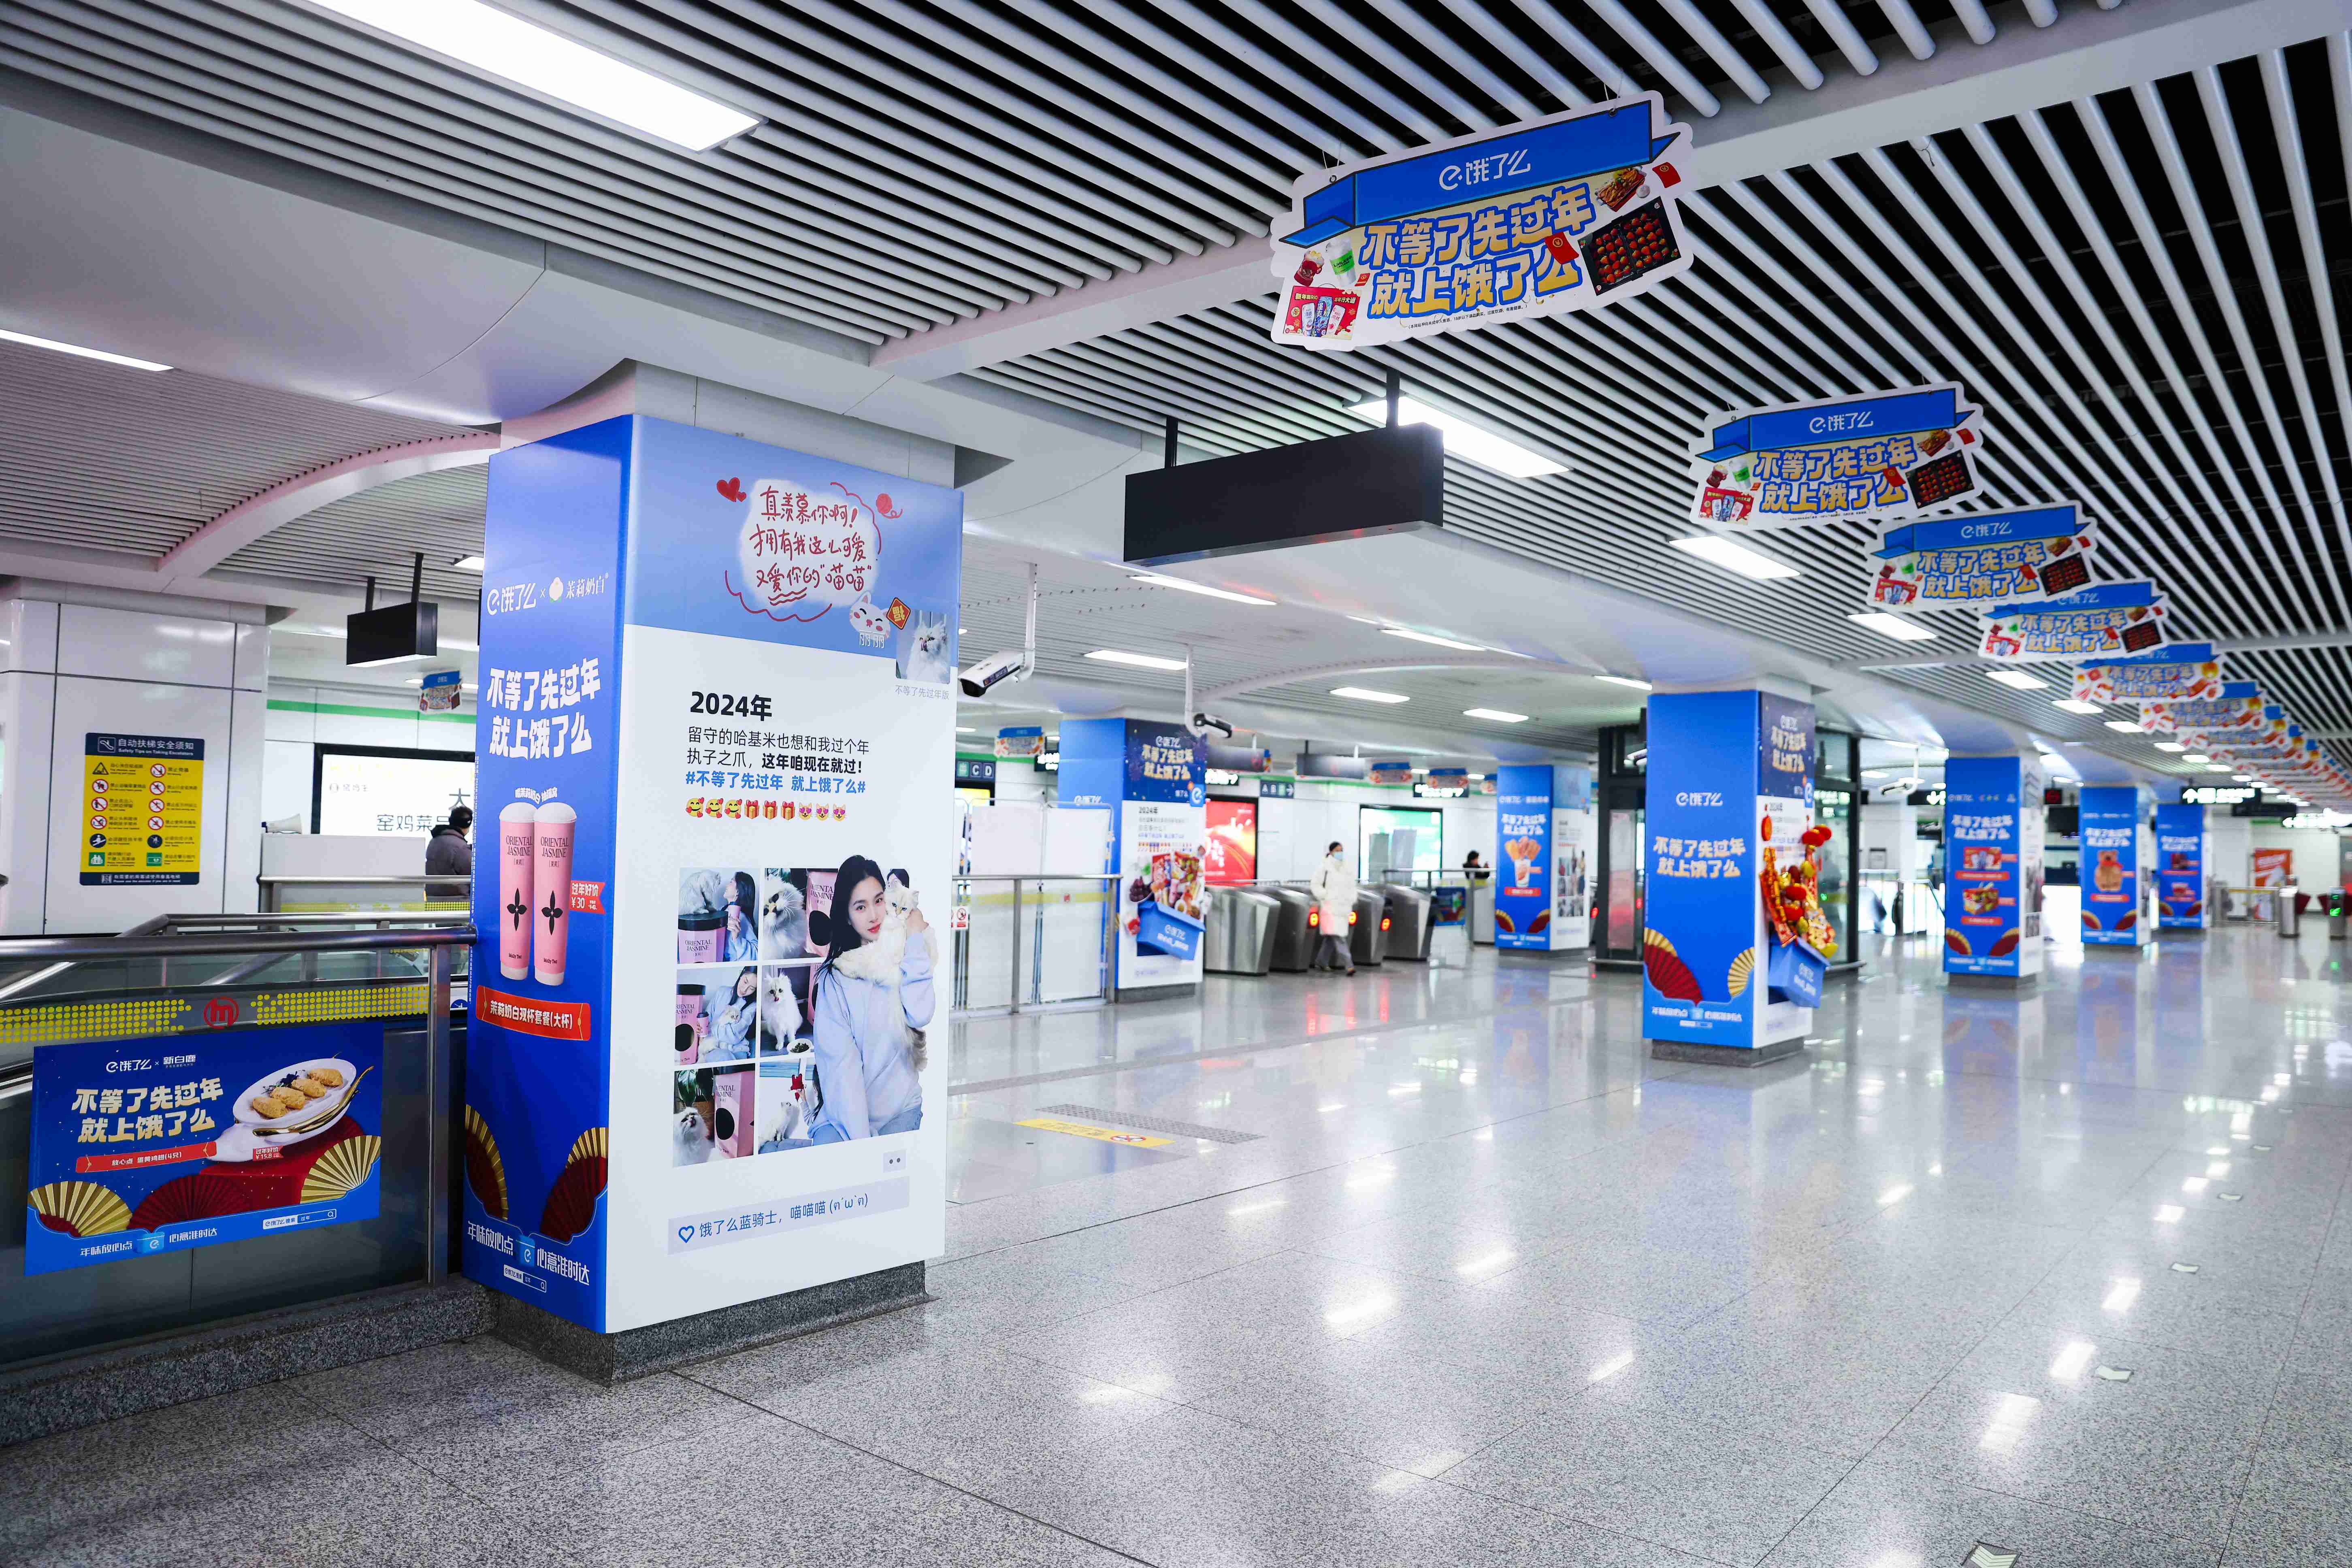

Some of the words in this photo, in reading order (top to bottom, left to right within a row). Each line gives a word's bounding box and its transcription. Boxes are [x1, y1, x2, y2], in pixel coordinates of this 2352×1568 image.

[1465, 149, 1530, 185] 饿了么
[1361, 183, 1595, 266] 不等了先过年
[1370, 243, 1583, 318] 就上饿了么
[1828, 411, 1873, 431] 饿了么
[1753, 437, 1917, 480] 不等了先过年
[1760, 473, 1908, 513] 就上饿了么
[750, 524, 866, 562] 拥有我这么可爱
[1916, 542, 2046, 573] 不等了先过年
[1922, 569, 2039, 599] 就上饿了么
[501, 583, 536, 613] 饿了么
[2021, 608, 2127, 634] 不等了先过年
[2025, 630, 2120, 655] 就上饿了么
[486, 657, 601, 712] 不等了先过年
[895, 685, 949, 700] 不等了先过年版
[690, 691, 772, 721] 2024年
[118, 739, 194, 750] 自动扶梯安全须知
[489, 711, 592, 761] 就上饿了么
[688, 726, 869, 755] 留守的哈基米也想和我过个年
[1142, 744, 1194, 764] 不等了先过年
[686, 771, 784, 790] #不等了先过年
[791, 775, 866, 794] 就上饿了么#
[972, 765, 980, 775] C
[985, 766, 992, 775] D
[506, 835, 533, 846] ORIENTAL
[507, 846, 531, 856] JASMINE
[541, 836, 569, 847] ORIENTAL
[542, 847, 567, 858] JASMINE
[1653, 835, 1746, 859] 不等了先过年
[1656, 856, 1741, 879] 就上饿了么
[571, 882, 599, 897] 过年好价
[120, 1059, 152, 1071] 饿了么
[163, 1055, 196, 1065] 新白鹿
[72, 1077, 223, 1115] 不等了先过年
[77, 1107, 215, 1144] 就上饿了么
[256, 1146, 279, 1155] 过年好价
[80, 1241, 132, 1257] 年味放心点
[169, 1227, 218, 1243] 心意准时达
[467, 1221, 513, 1256] 年味放心点
[537, 1248, 590, 1286] 心意准时达
